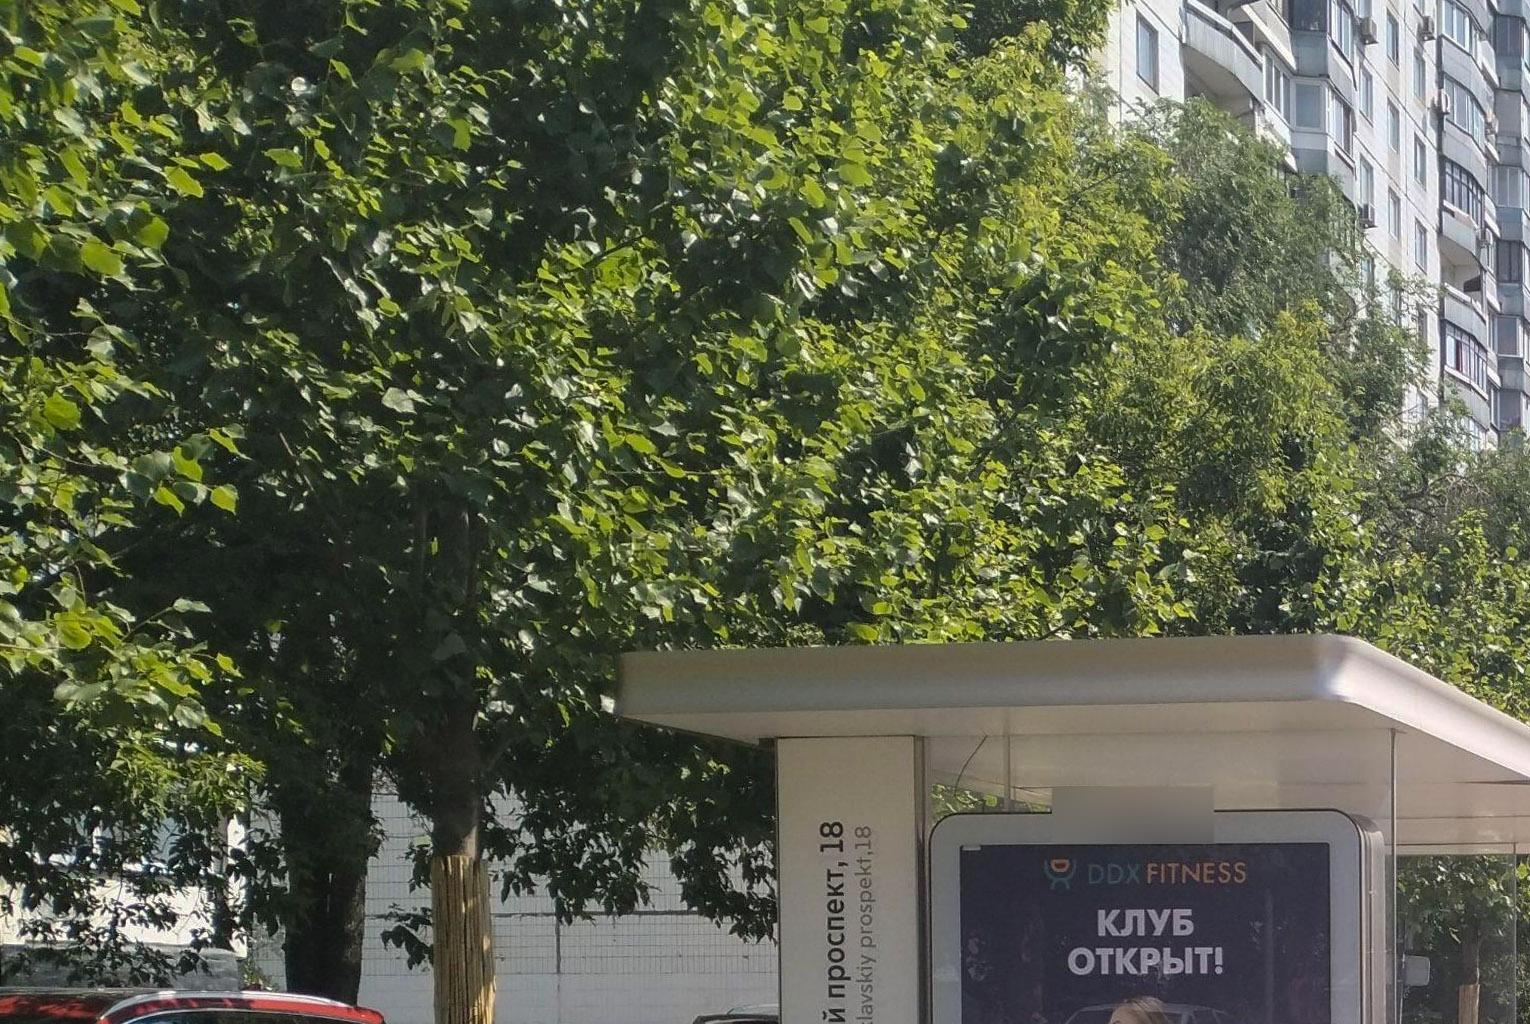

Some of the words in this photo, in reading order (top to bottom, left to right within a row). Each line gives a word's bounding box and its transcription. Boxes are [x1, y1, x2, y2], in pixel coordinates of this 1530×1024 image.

[819, 821, 844, 853] 18
[1088, 862, 1141, 885] DDX
[1146, 861, 1247, 884] FITNESS
[826, 861, 851, 999] проспект,
[1097, 908, 1195, 937] КЛУБ
[1067, 946, 1224, 976] ОТКРЫТ!
